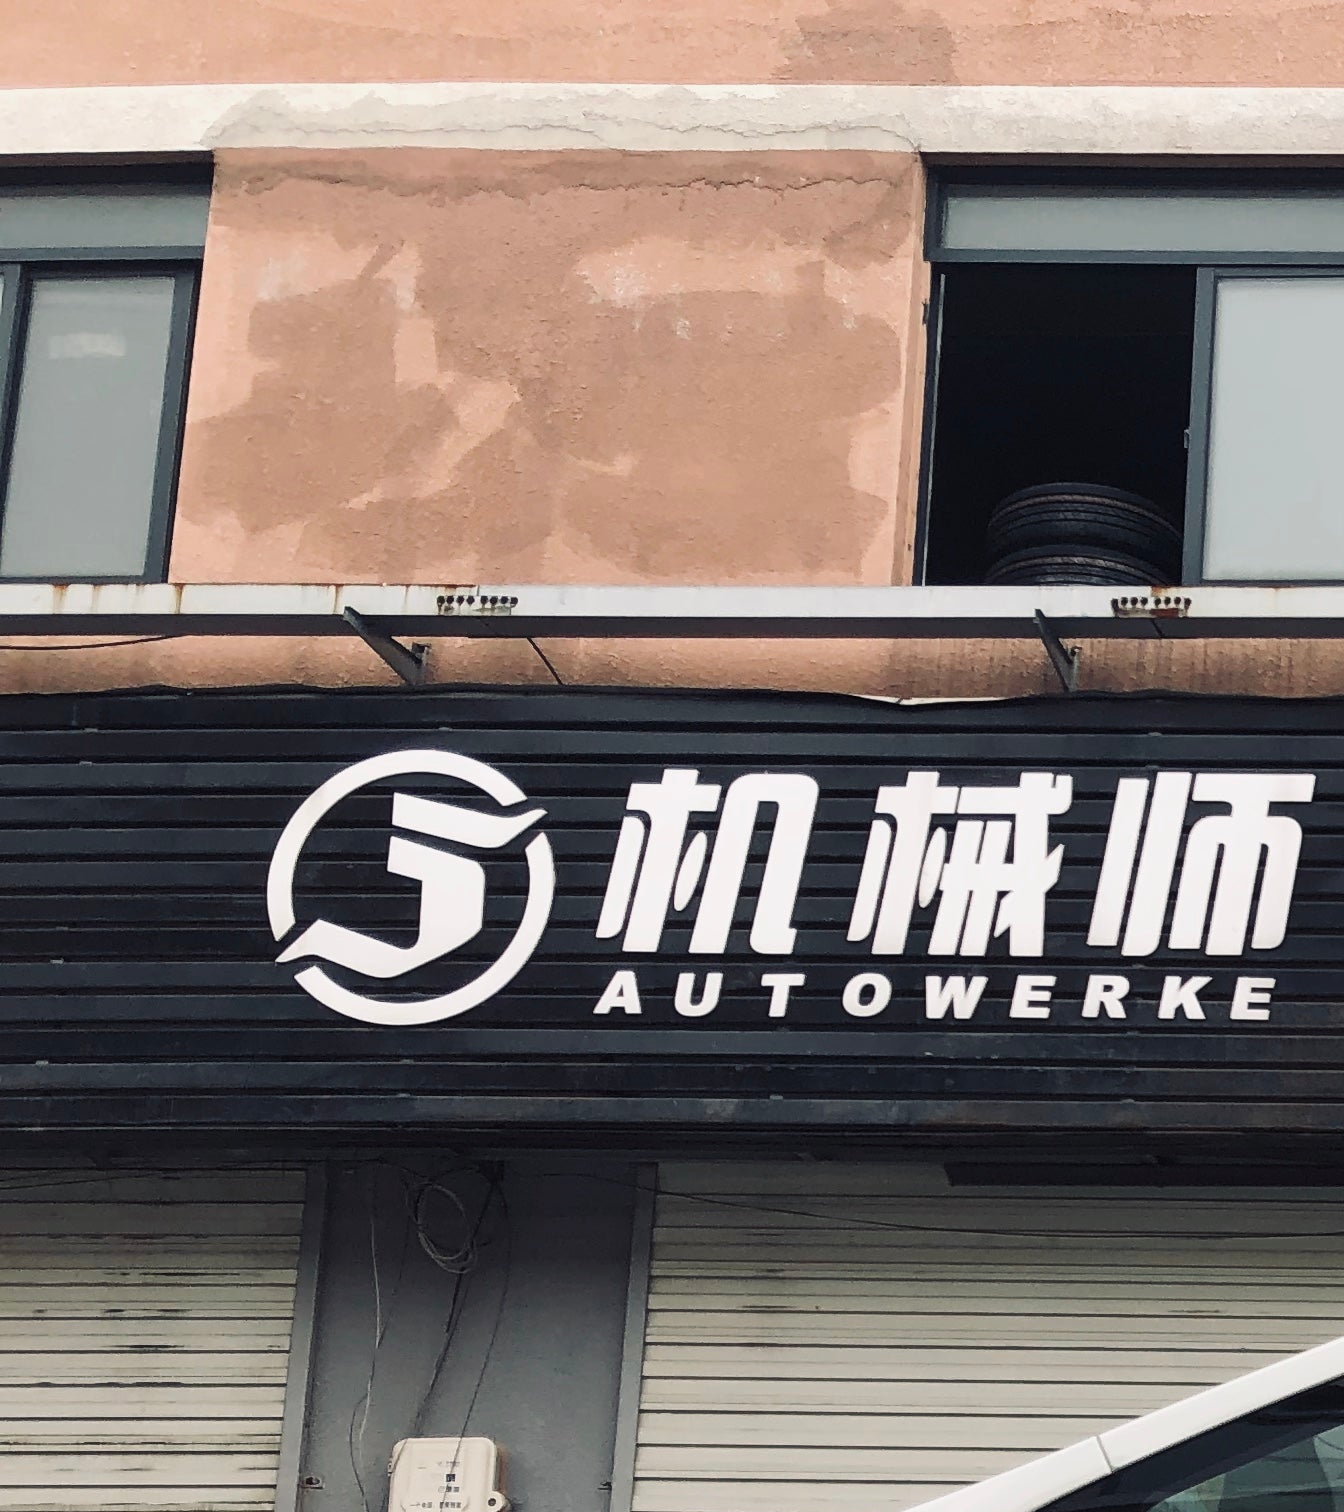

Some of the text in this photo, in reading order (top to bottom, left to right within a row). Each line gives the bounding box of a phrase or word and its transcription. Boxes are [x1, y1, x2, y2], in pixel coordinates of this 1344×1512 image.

[595, 769, 1317, 957] 机械师
[593, 970, 1276, 1022] AUTOWERKE
